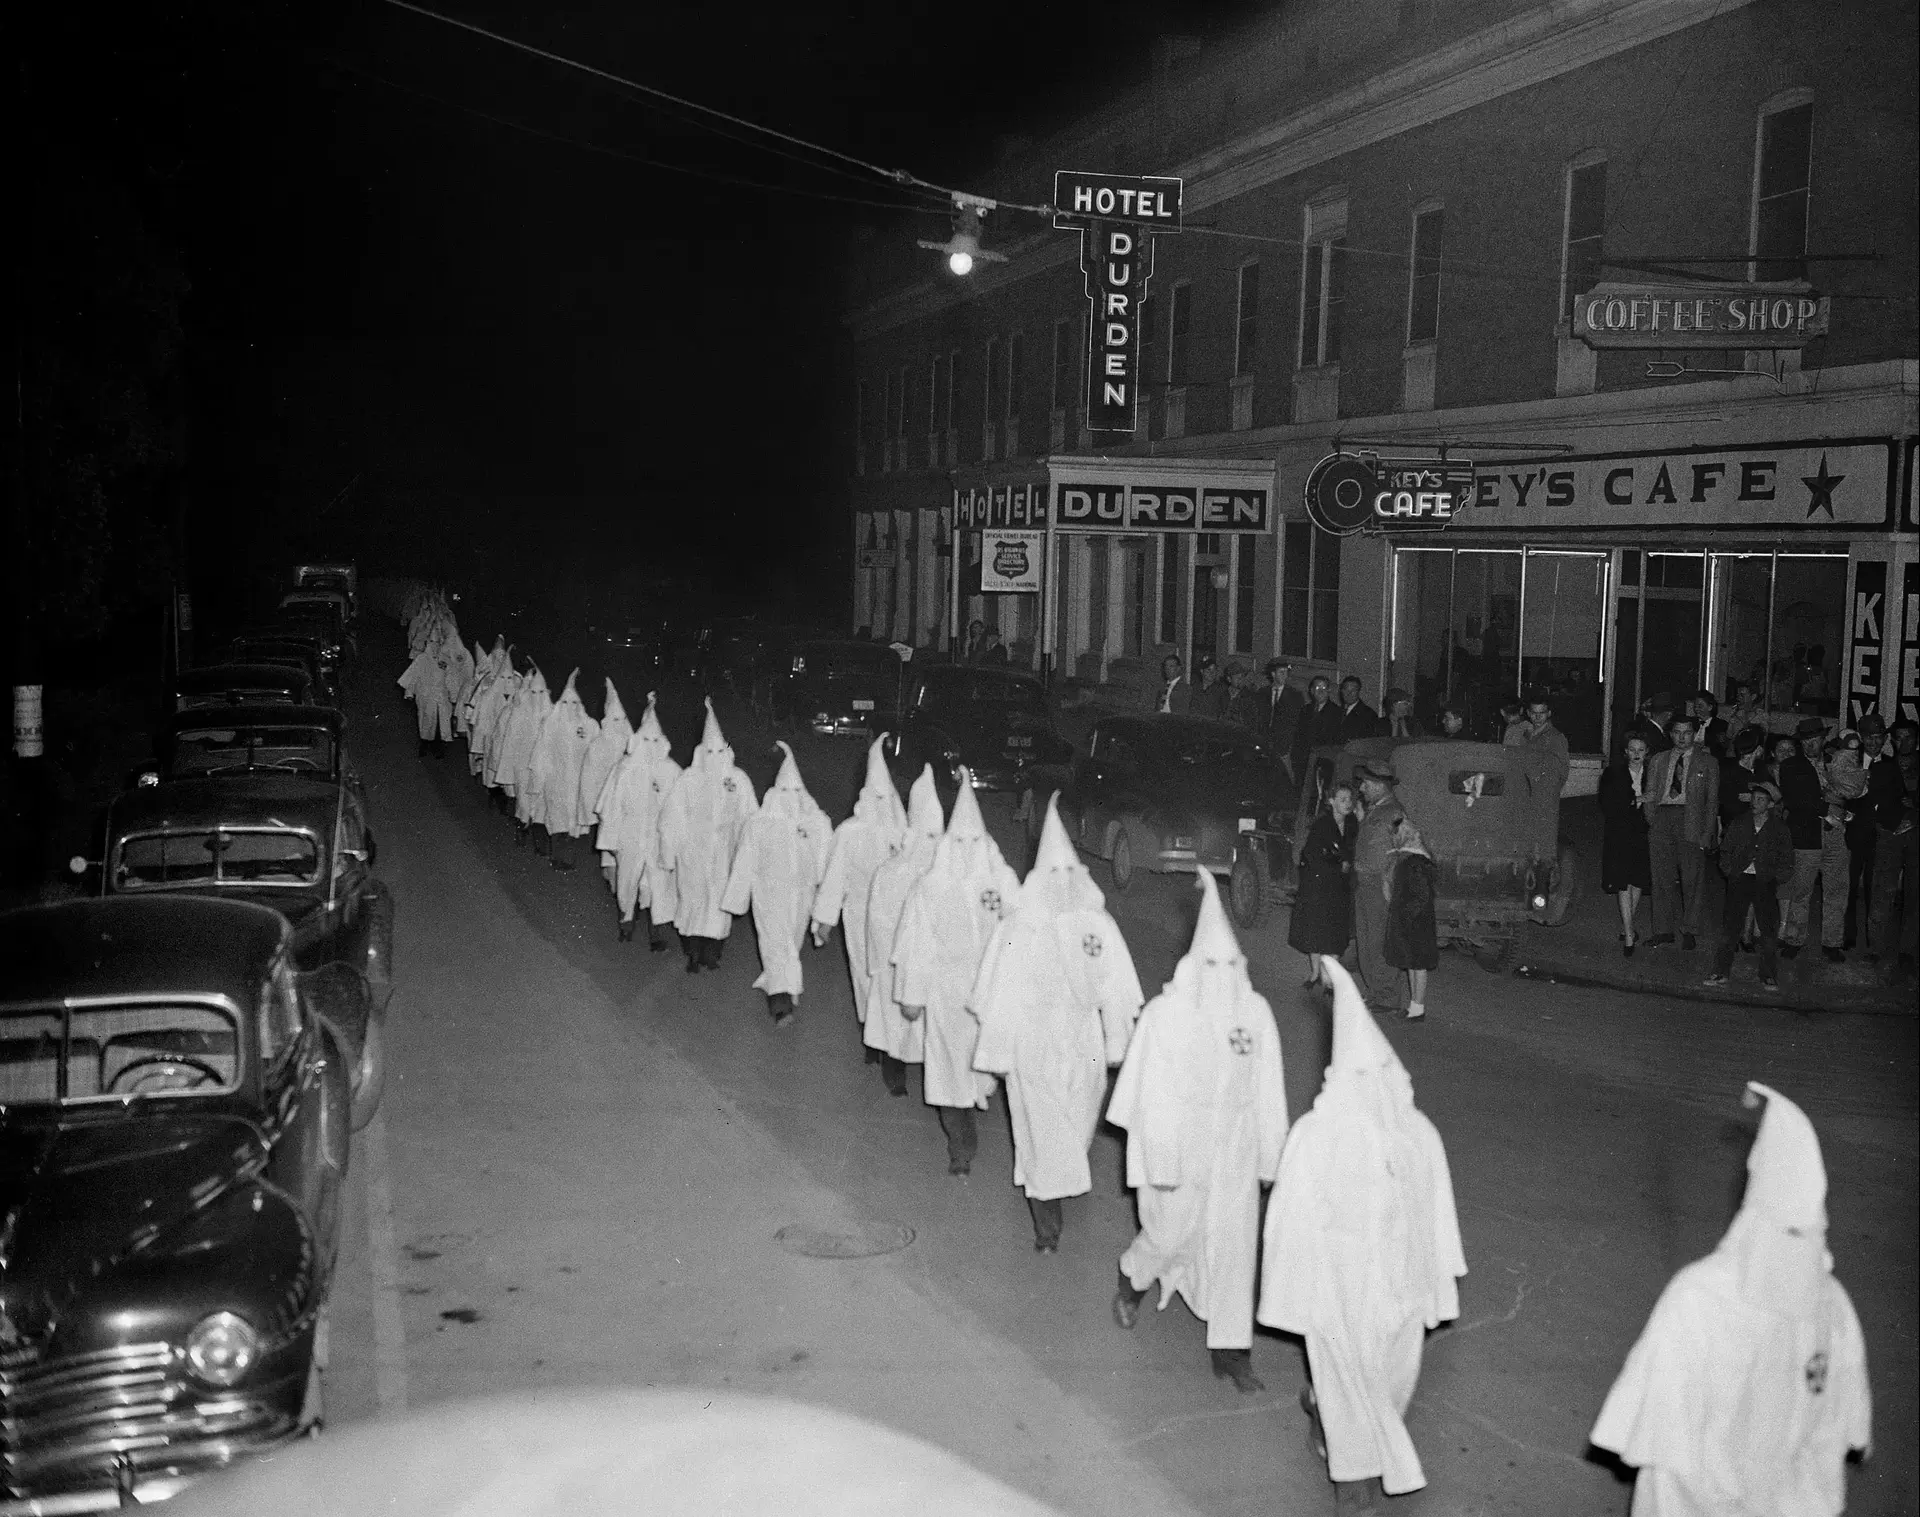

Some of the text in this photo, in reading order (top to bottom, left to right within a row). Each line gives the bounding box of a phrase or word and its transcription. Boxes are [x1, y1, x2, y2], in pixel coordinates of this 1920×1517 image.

[1074, 185, 1172, 218] HOTEL
[1103, 232, 1133, 407] DURDEN
[1586, 298, 1817, 332] COFFEE SHOP
[1390, 470, 1443, 488] KEY'S
[1473, 460, 1778, 507] EY'S CAFE
[961, 491, 1045, 520] HOTEL
[1064, 490, 1260, 523] DURDEN
[1374, 491, 1452, 518] CAFE
